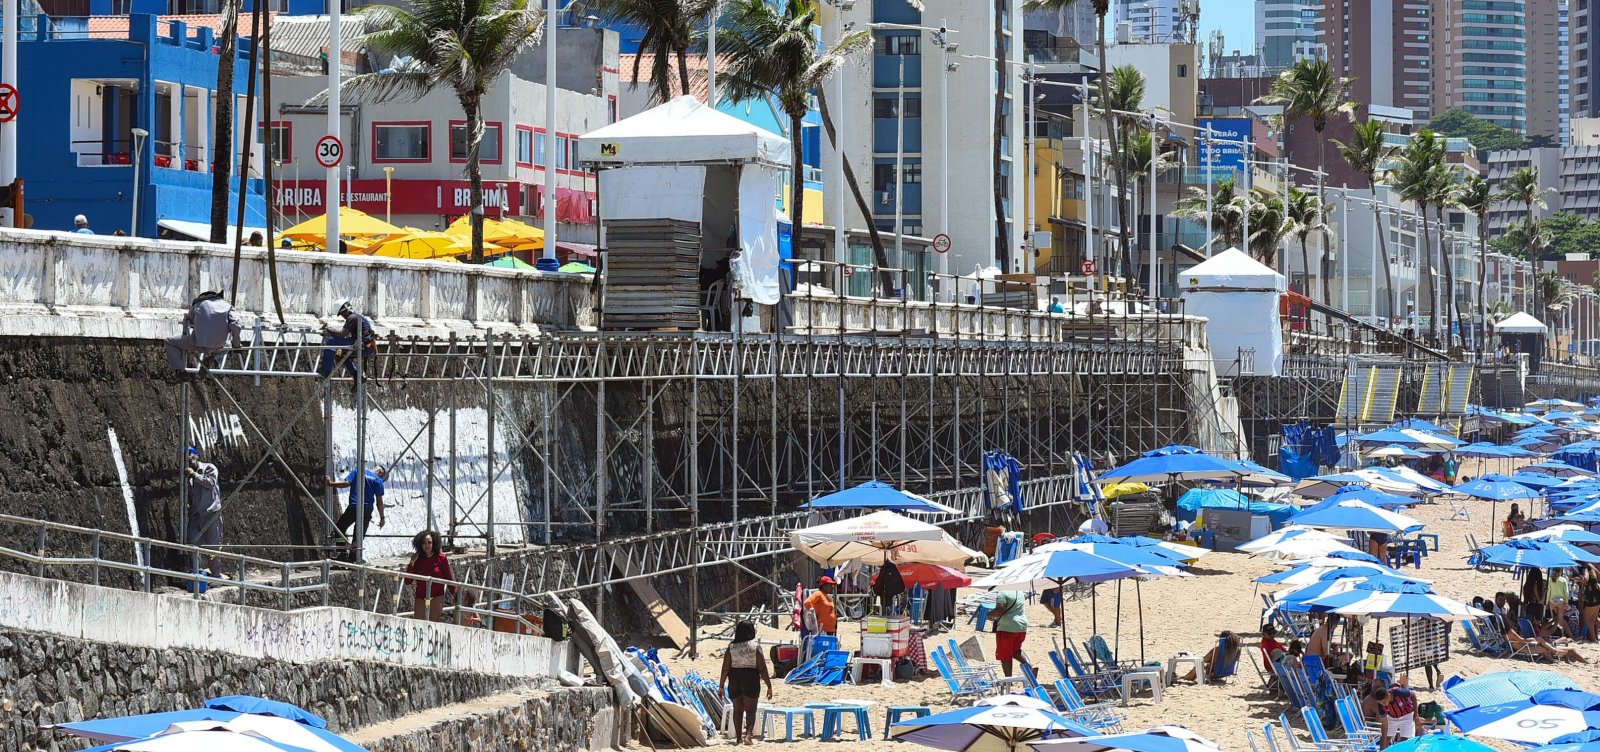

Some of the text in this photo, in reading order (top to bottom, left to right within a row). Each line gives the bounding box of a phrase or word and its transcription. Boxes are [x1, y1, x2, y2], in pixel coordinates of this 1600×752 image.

[320, 143, 340, 157] 30
[601, 143, 617, 156] M4
[276, 187, 322, 206] ARUBA
[346, 192, 392, 202] ESTAURANT
[454, 188, 509, 207] BRHMA
